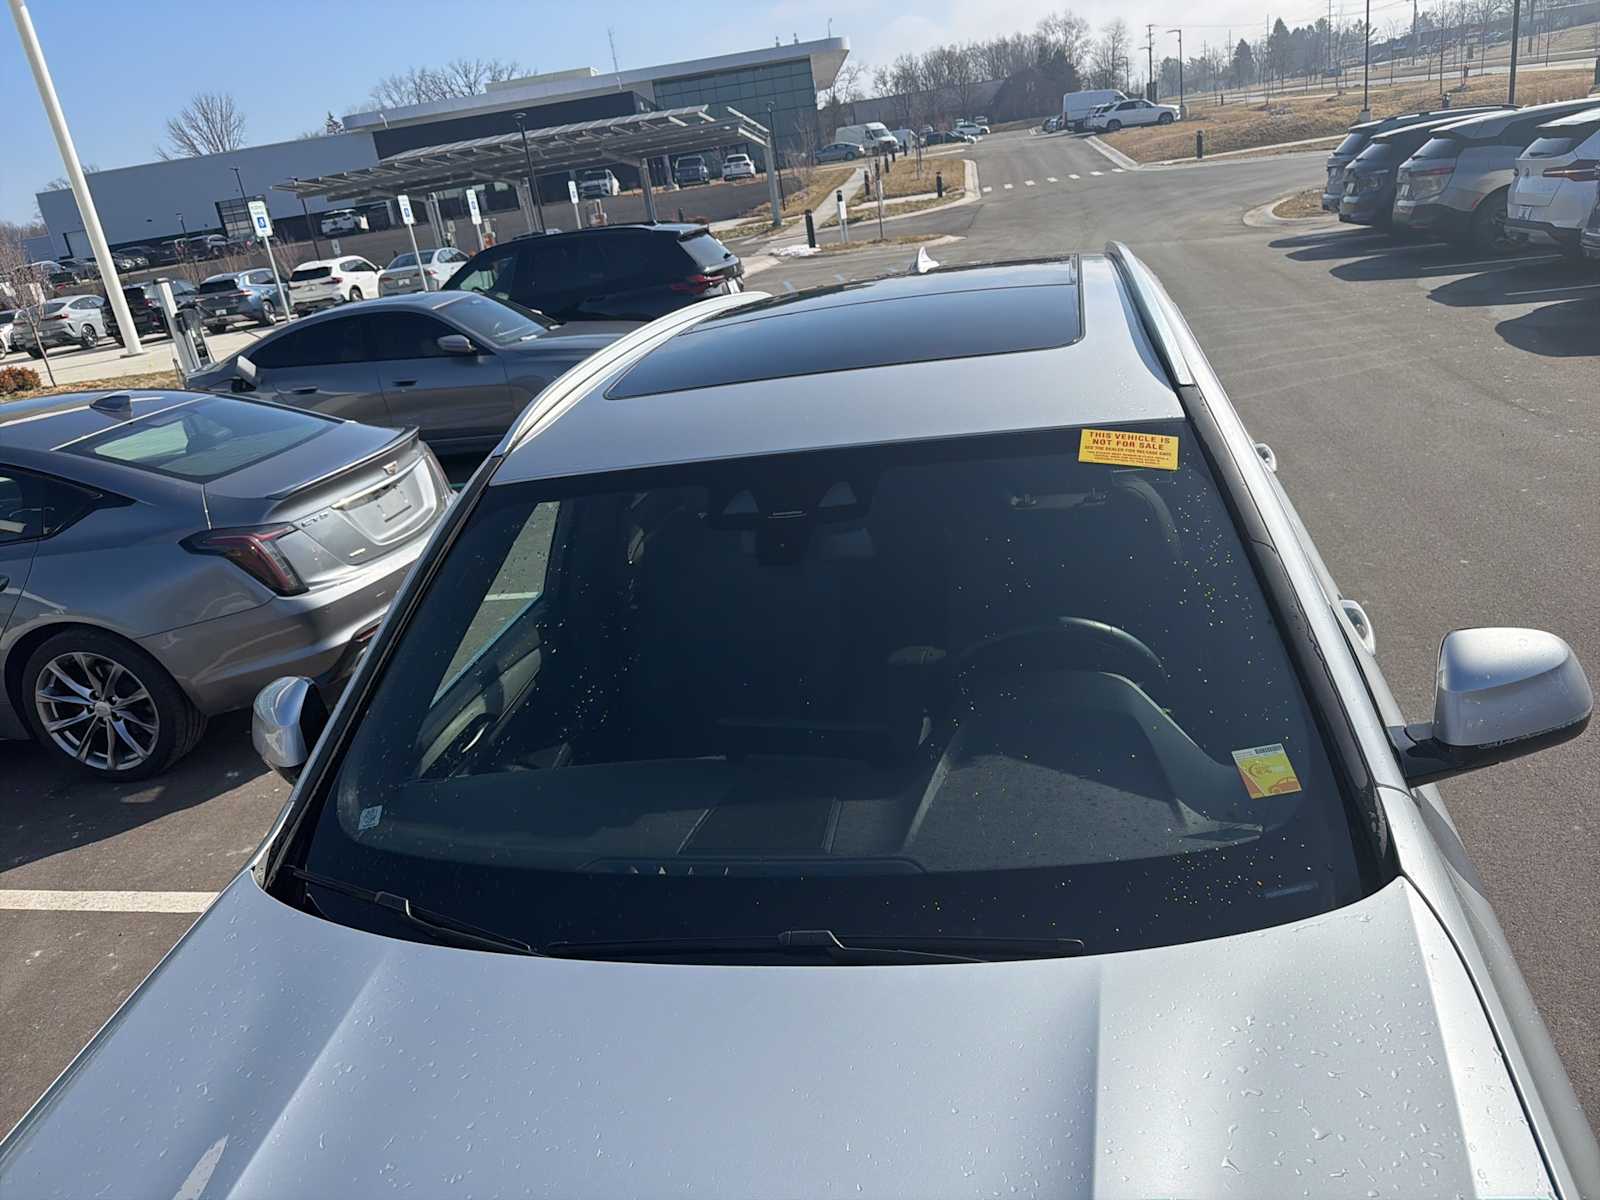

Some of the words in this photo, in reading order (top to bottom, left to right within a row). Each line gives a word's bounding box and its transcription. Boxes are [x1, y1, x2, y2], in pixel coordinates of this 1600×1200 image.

[1089, 431, 1112, 439] THIS
[1114, 433, 1158, 444] VEHICLE
[1092, 438, 1112, 446] NOT
[1116, 440, 1136, 448] FOR
[1139, 442, 1166, 450] SALE
